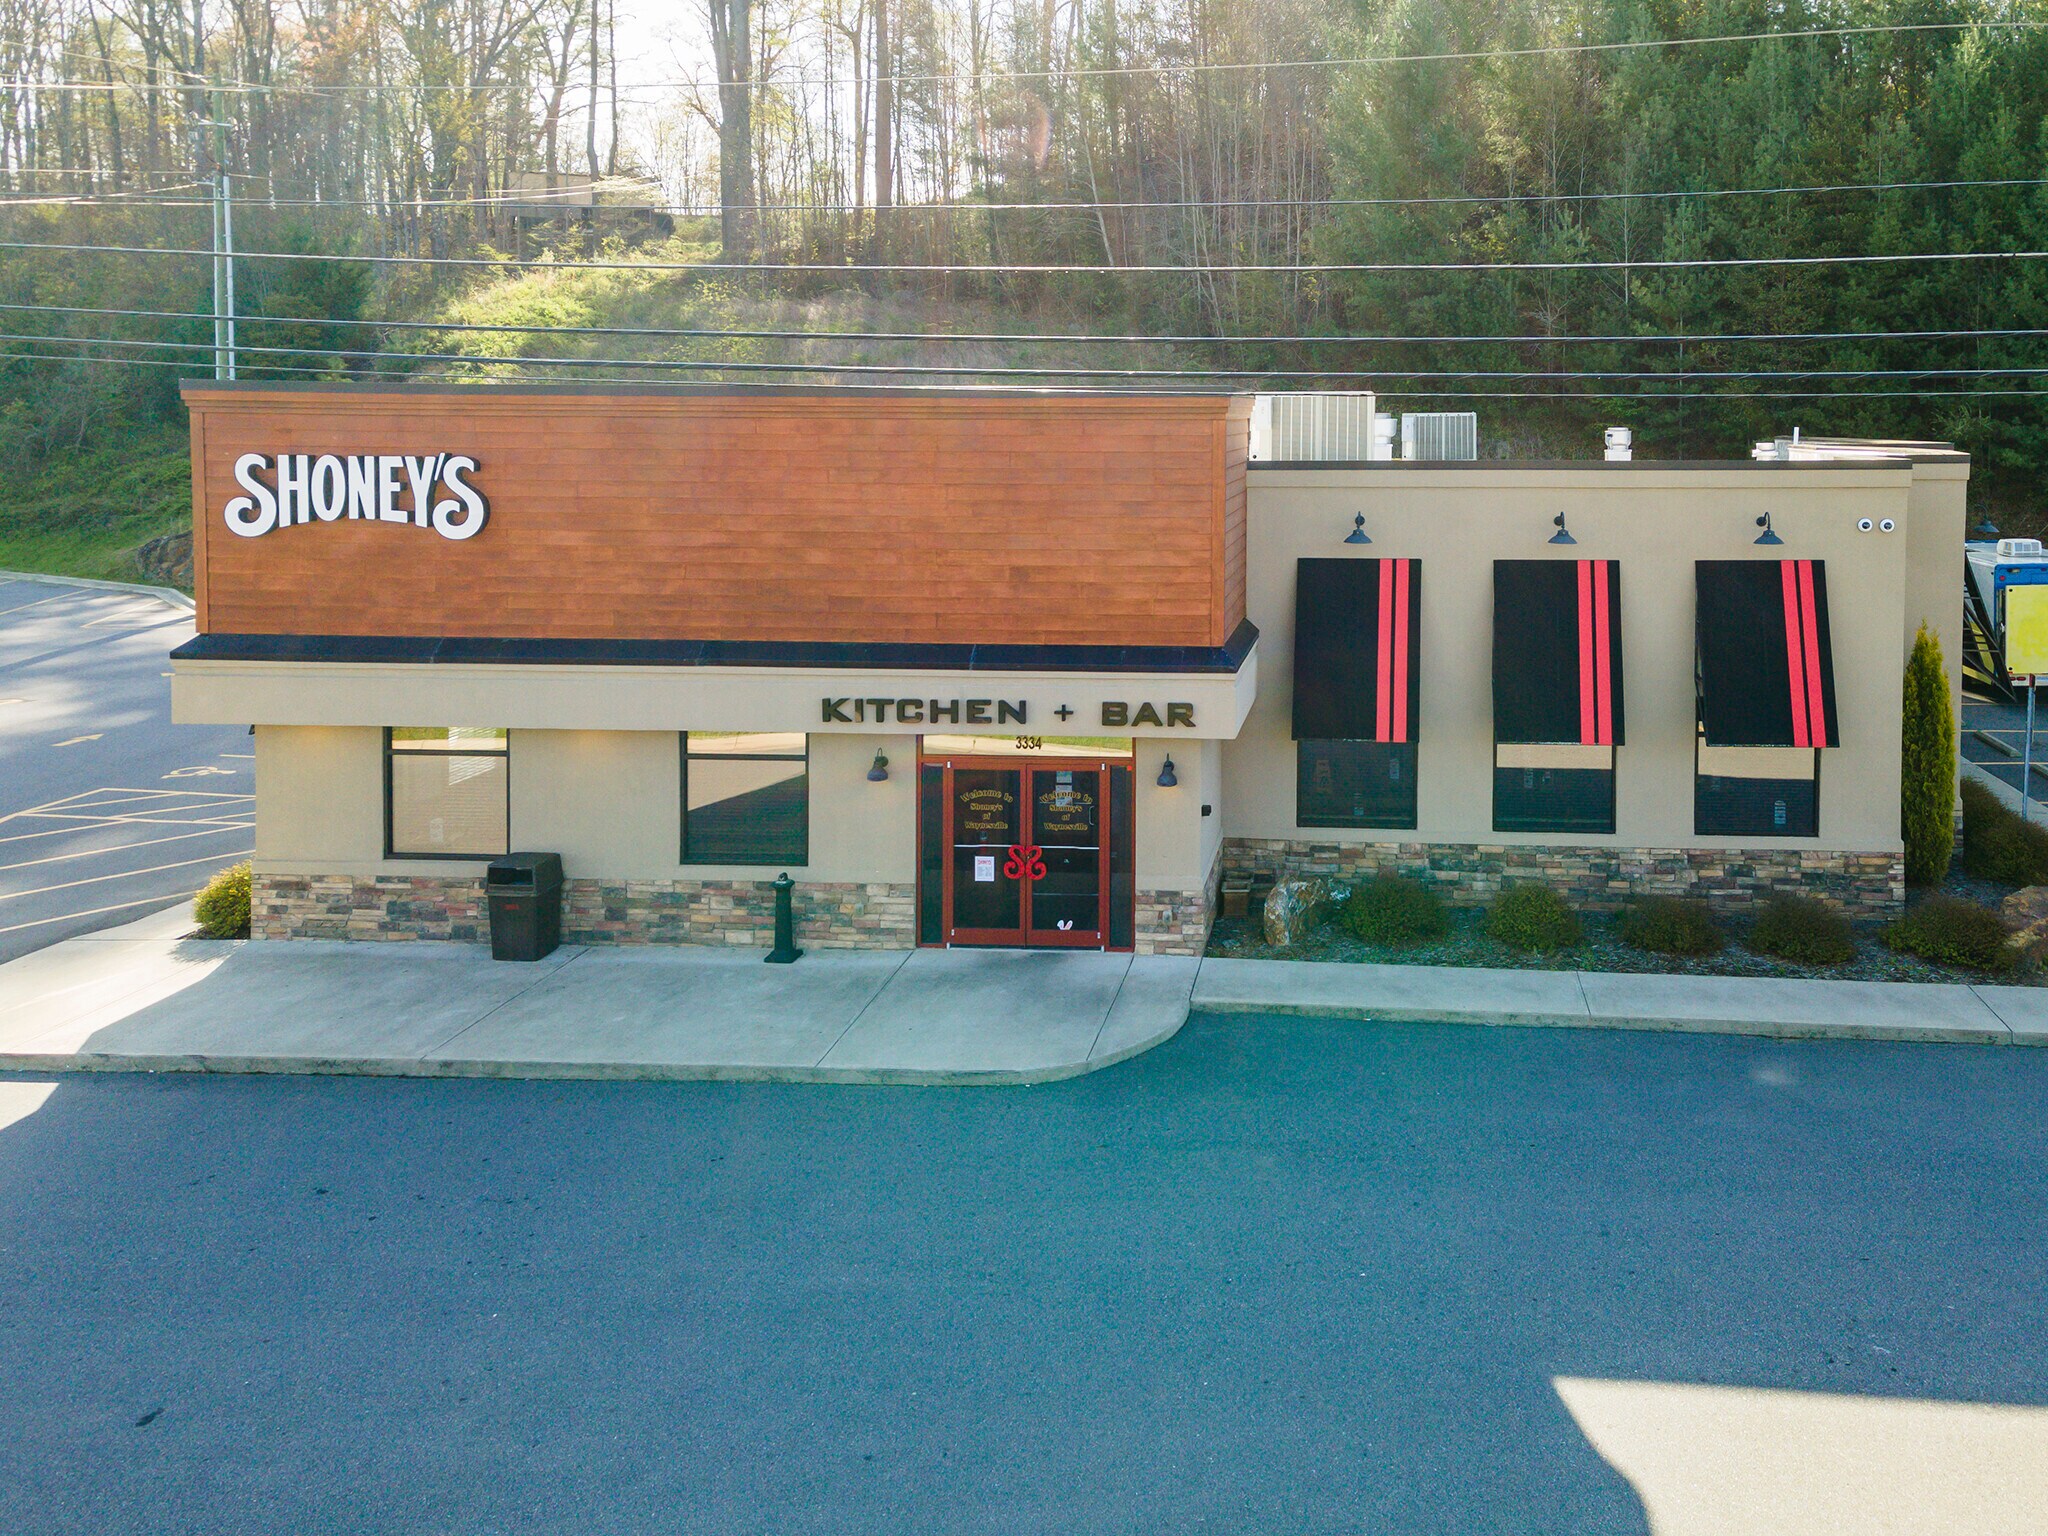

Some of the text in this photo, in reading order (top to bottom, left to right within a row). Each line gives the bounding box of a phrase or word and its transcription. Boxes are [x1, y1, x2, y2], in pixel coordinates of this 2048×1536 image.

[224, 452, 489, 541] SHONEY'S
[821, 697, 1027, 725] KITCHEN
[1101, 701, 1197, 728] BAR
[1015, 736, 1042, 750] 3334
